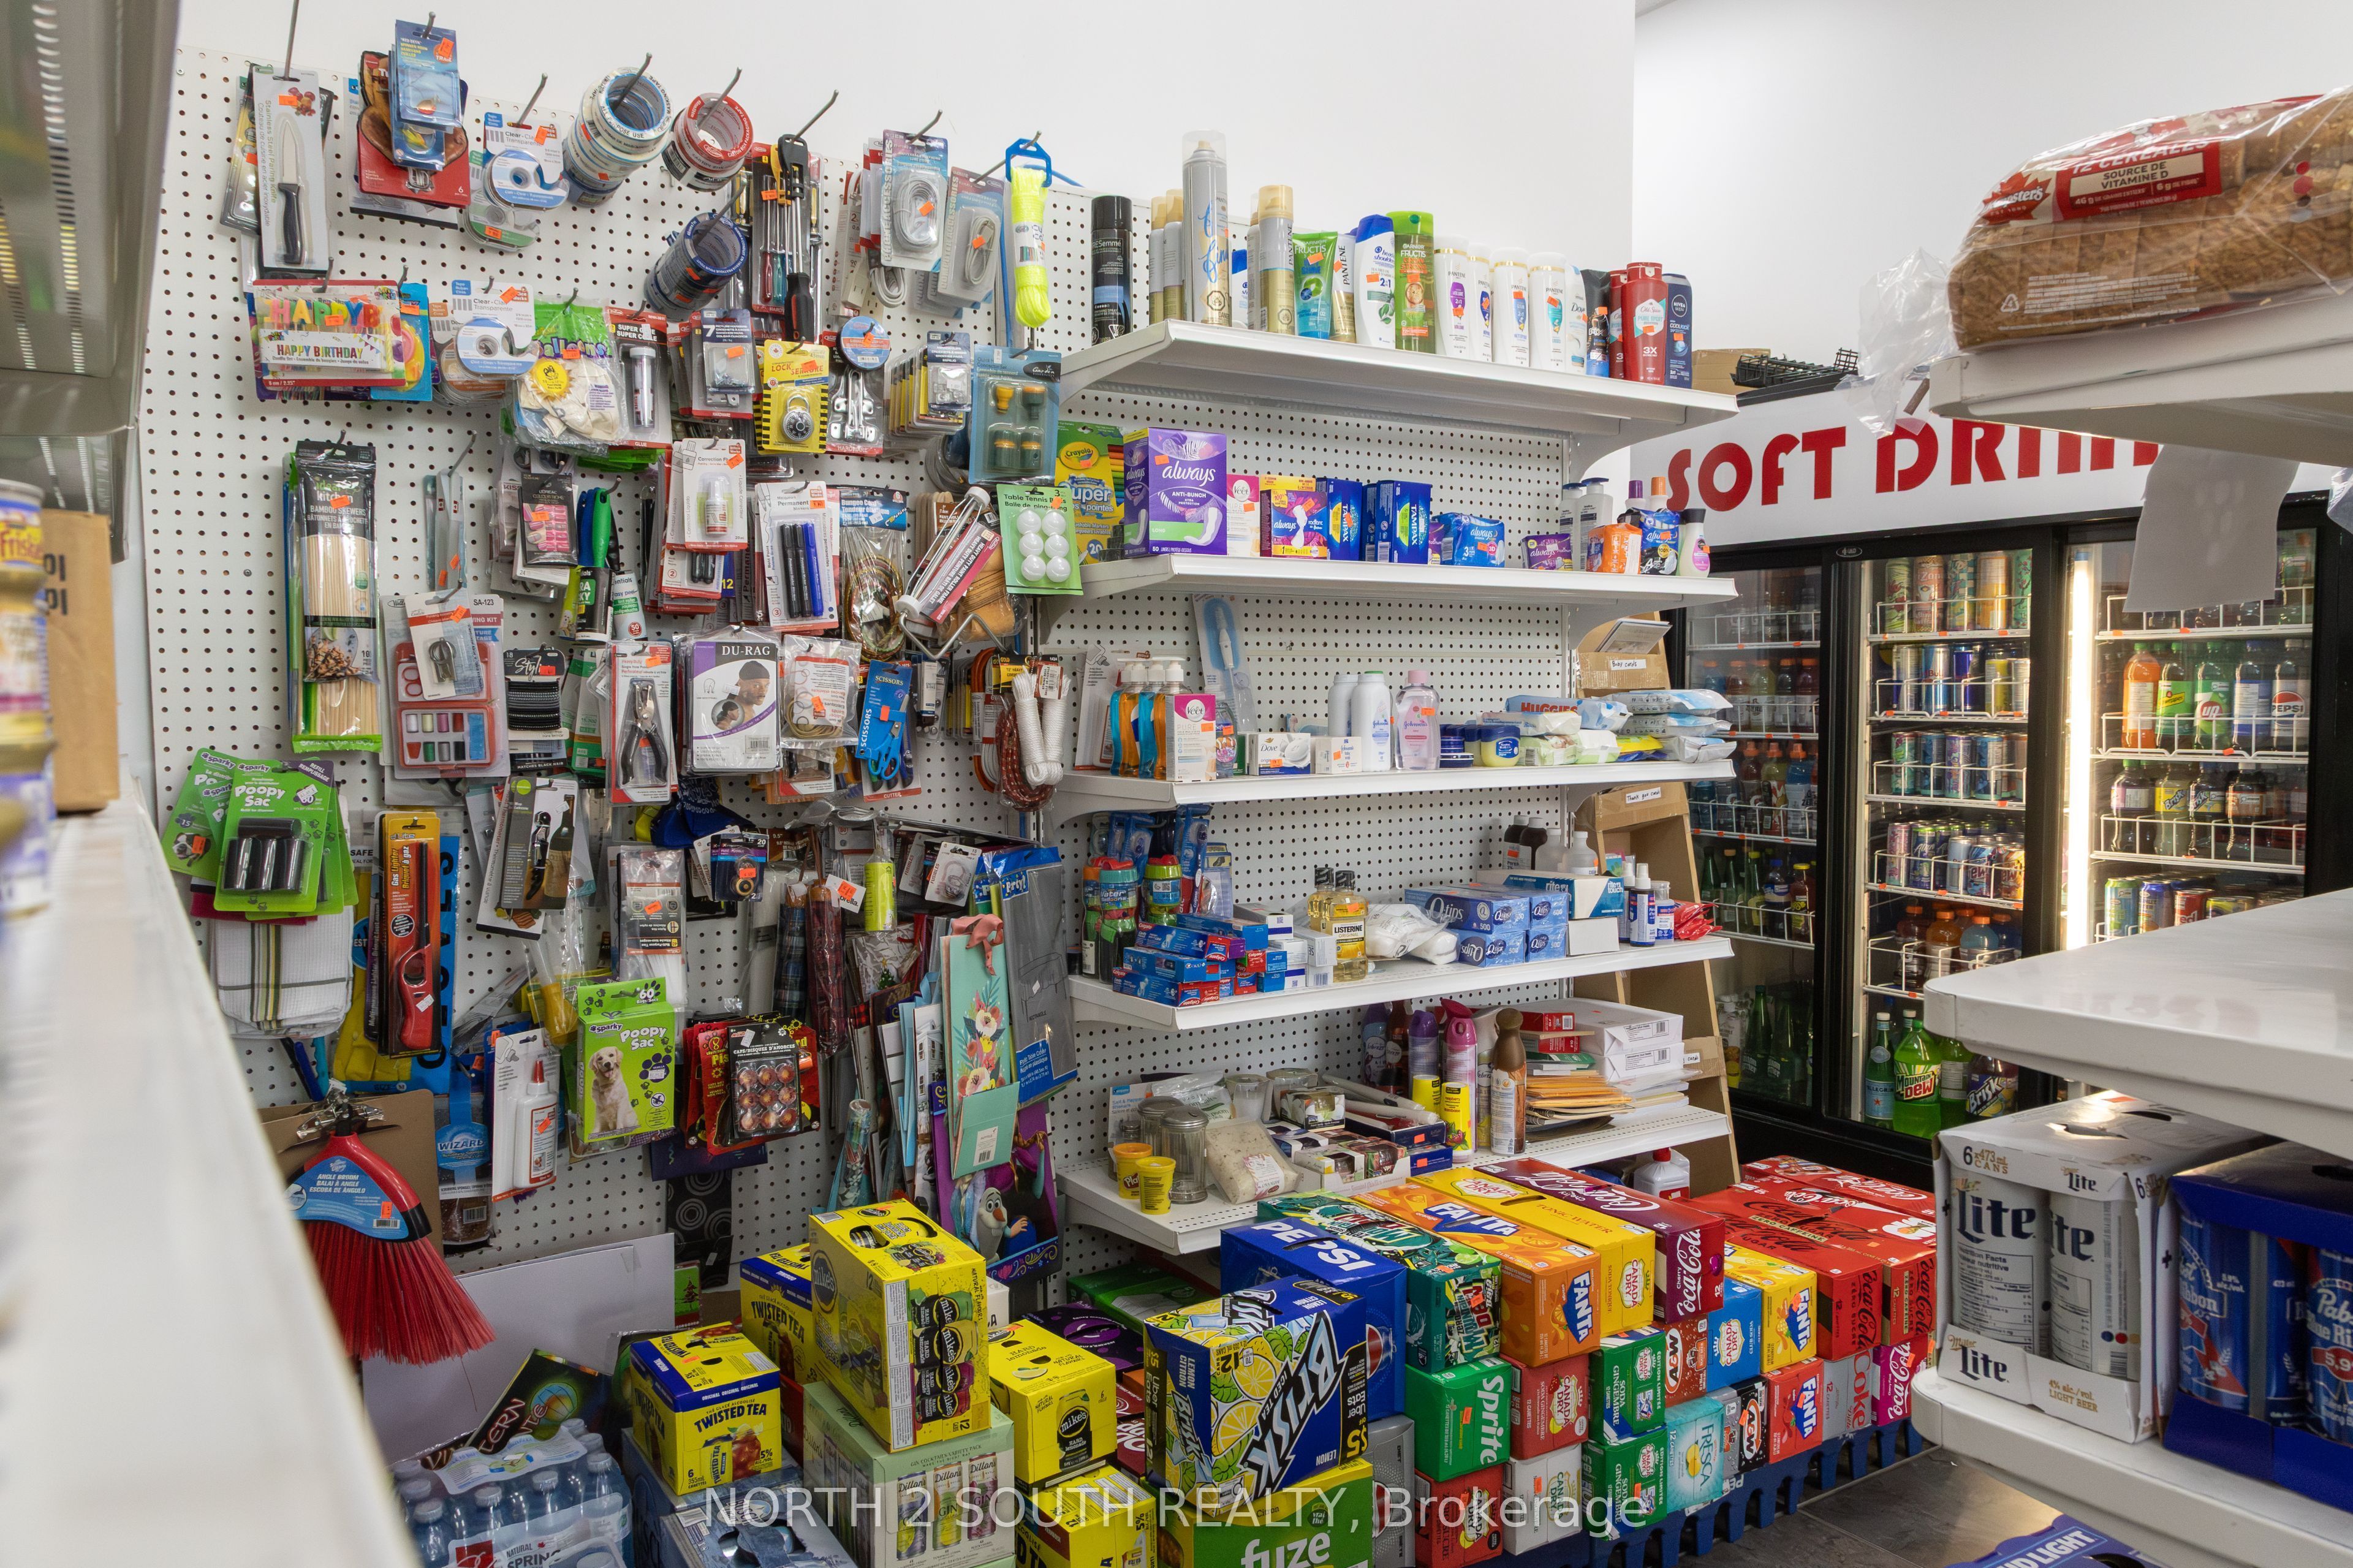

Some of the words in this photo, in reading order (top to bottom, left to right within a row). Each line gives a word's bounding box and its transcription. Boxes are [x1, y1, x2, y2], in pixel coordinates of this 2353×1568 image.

[2102, 165, 2148, 180] SOURCE
[2151, 161, 2167, 172] DE
[2101, 172, 2156, 190] VITAMINE
[2160, 169, 2169, 179] D
[1295, 244, 1327, 254] FRUCTIS
[1338, 245, 1349, 286] PANTENE
[616, 330, 636, 339] SUPER
[618, 324, 637, 333] SUPER
[703, 324, 715, 337] 7
[277, 344, 311, 357] HAPPY
[314, 346, 363, 359] BIRTHDAY
[771, 363, 792, 373] LOCK
[1031, 365, 1056, 375] Garden
[837, 445, 868, 453] HARDWARE
[1065, 447, 1091, 459] Crayola
[1162, 461, 1216, 485] always
[1666, 425, 1846, 512] SOFT
[1876, 419, 2161, 494] DRI
[1126, 466, 1146, 481] always
[1233, 486, 1250, 495] Veet
[1086, 504, 1113, 513] pointes
[1273, 520, 1297, 531] always
[1409, 504, 1418, 545] TAMPAX
[1471, 527, 1493, 537] always
[1088, 542, 1102, 555] 20
[1464, 546, 1470, 556] 3
[1530, 547, 1555, 558] always
[721, 645, 770, 656] DU-RAG
[1612, 660, 1624, 668] Baby
[874, 675, 904, 686] SCISSORS
[1186, 705, 1205, 716] Veet
[1521, 702, 1578, 714] HUGGIES
[2272, 703, 2305, 713] PEPSI
[860, 708, 873, 747] SCISSORS
[1260, 743, 1278, 752] Dove
[298, 763, 330, 782] REMPLISSAGE
[309, 763, 325, 773] REFILL
[235, 785, 286, 799] Poopy
[244, 796, 270, 807] Sac
[1429, 900, 1464, 920] Q-tips
[1334, 925, 1363, 934] LISTERINE
[639, 990, 654, 999] 60
[620, 1026, 667, 1042] Poopy
[631, 1038, 655, 1051] Sac
[1896, 1074, 1931, 1091] MOUNTAIN
[438, 1138, 485, 1151] WIZARD
[1963, 1145, 1973, 1165] 6
[1974, 1161, 2009, 1175] CANS
[1469, 1178, 1520, 1198] CANADA
[2066, 1170, 2097, 1192] Lite
[1466, 1183, 1492, 1197] DRY
[1536, 1203, 1568, 1223] TONIC
[1572, 1213, 1613, 1236] WATER
[1956, 1186, 2037, 1244] Lite
[1677, 1227, 1702, 1316] Coca-Cola
[1622, 1274, 1631, 1299] DRY
[1630, 1259, 1639, 1309] CANADA
[1573, 1270, 1592, 1343] FANTA
[1797, 1289, 1810, 1352] FANTA
[1959, 1344, 2010, 1384] Lite
[702, 1392, 719, 1401] ORIGINAL
[721, 1387, 739, 1397] ORIGINAL
[740, 1382, 759, 1393] ORIGINAL
[1852, 1350, 1870, 1427] Coke
[1556, 1388, 1564, 1417] DRY
[1562, 1374, 1571, 1427] CANADA
[1803, 1376, 1817, 1439] FANTA
[2049, 1389, 2074, 1404] LIGHT
[2076, 1396, 2098, 1412] BEER
[694, 1406, 745, 1433] TWISTED
[746, 1403, 767, 1417] TEA
[960, 1418, 969, 1431] 12
[1060, 1411, 1087, 1433] mike's
[1476, 1374, 1505, 1466] Sprite
[1069, 1437, 1083, 1446] HARD
[1347, 1425, 1367, 1457] $5
[1670, 1430, 1676, 1441] 12
[761, 1449, 773, 1458] 5%
[1065, 1441, 1086, 1451] lemonade
[1316, 1449, 1337, 1466] LEMON
[1699, 1423, 1715, 1488] FRESCA
[688, 1469, 694, 1478] 6
[506, 1542, 532, 1558] NATURAL
[1241, 1532, 1332, 1568] fuze
